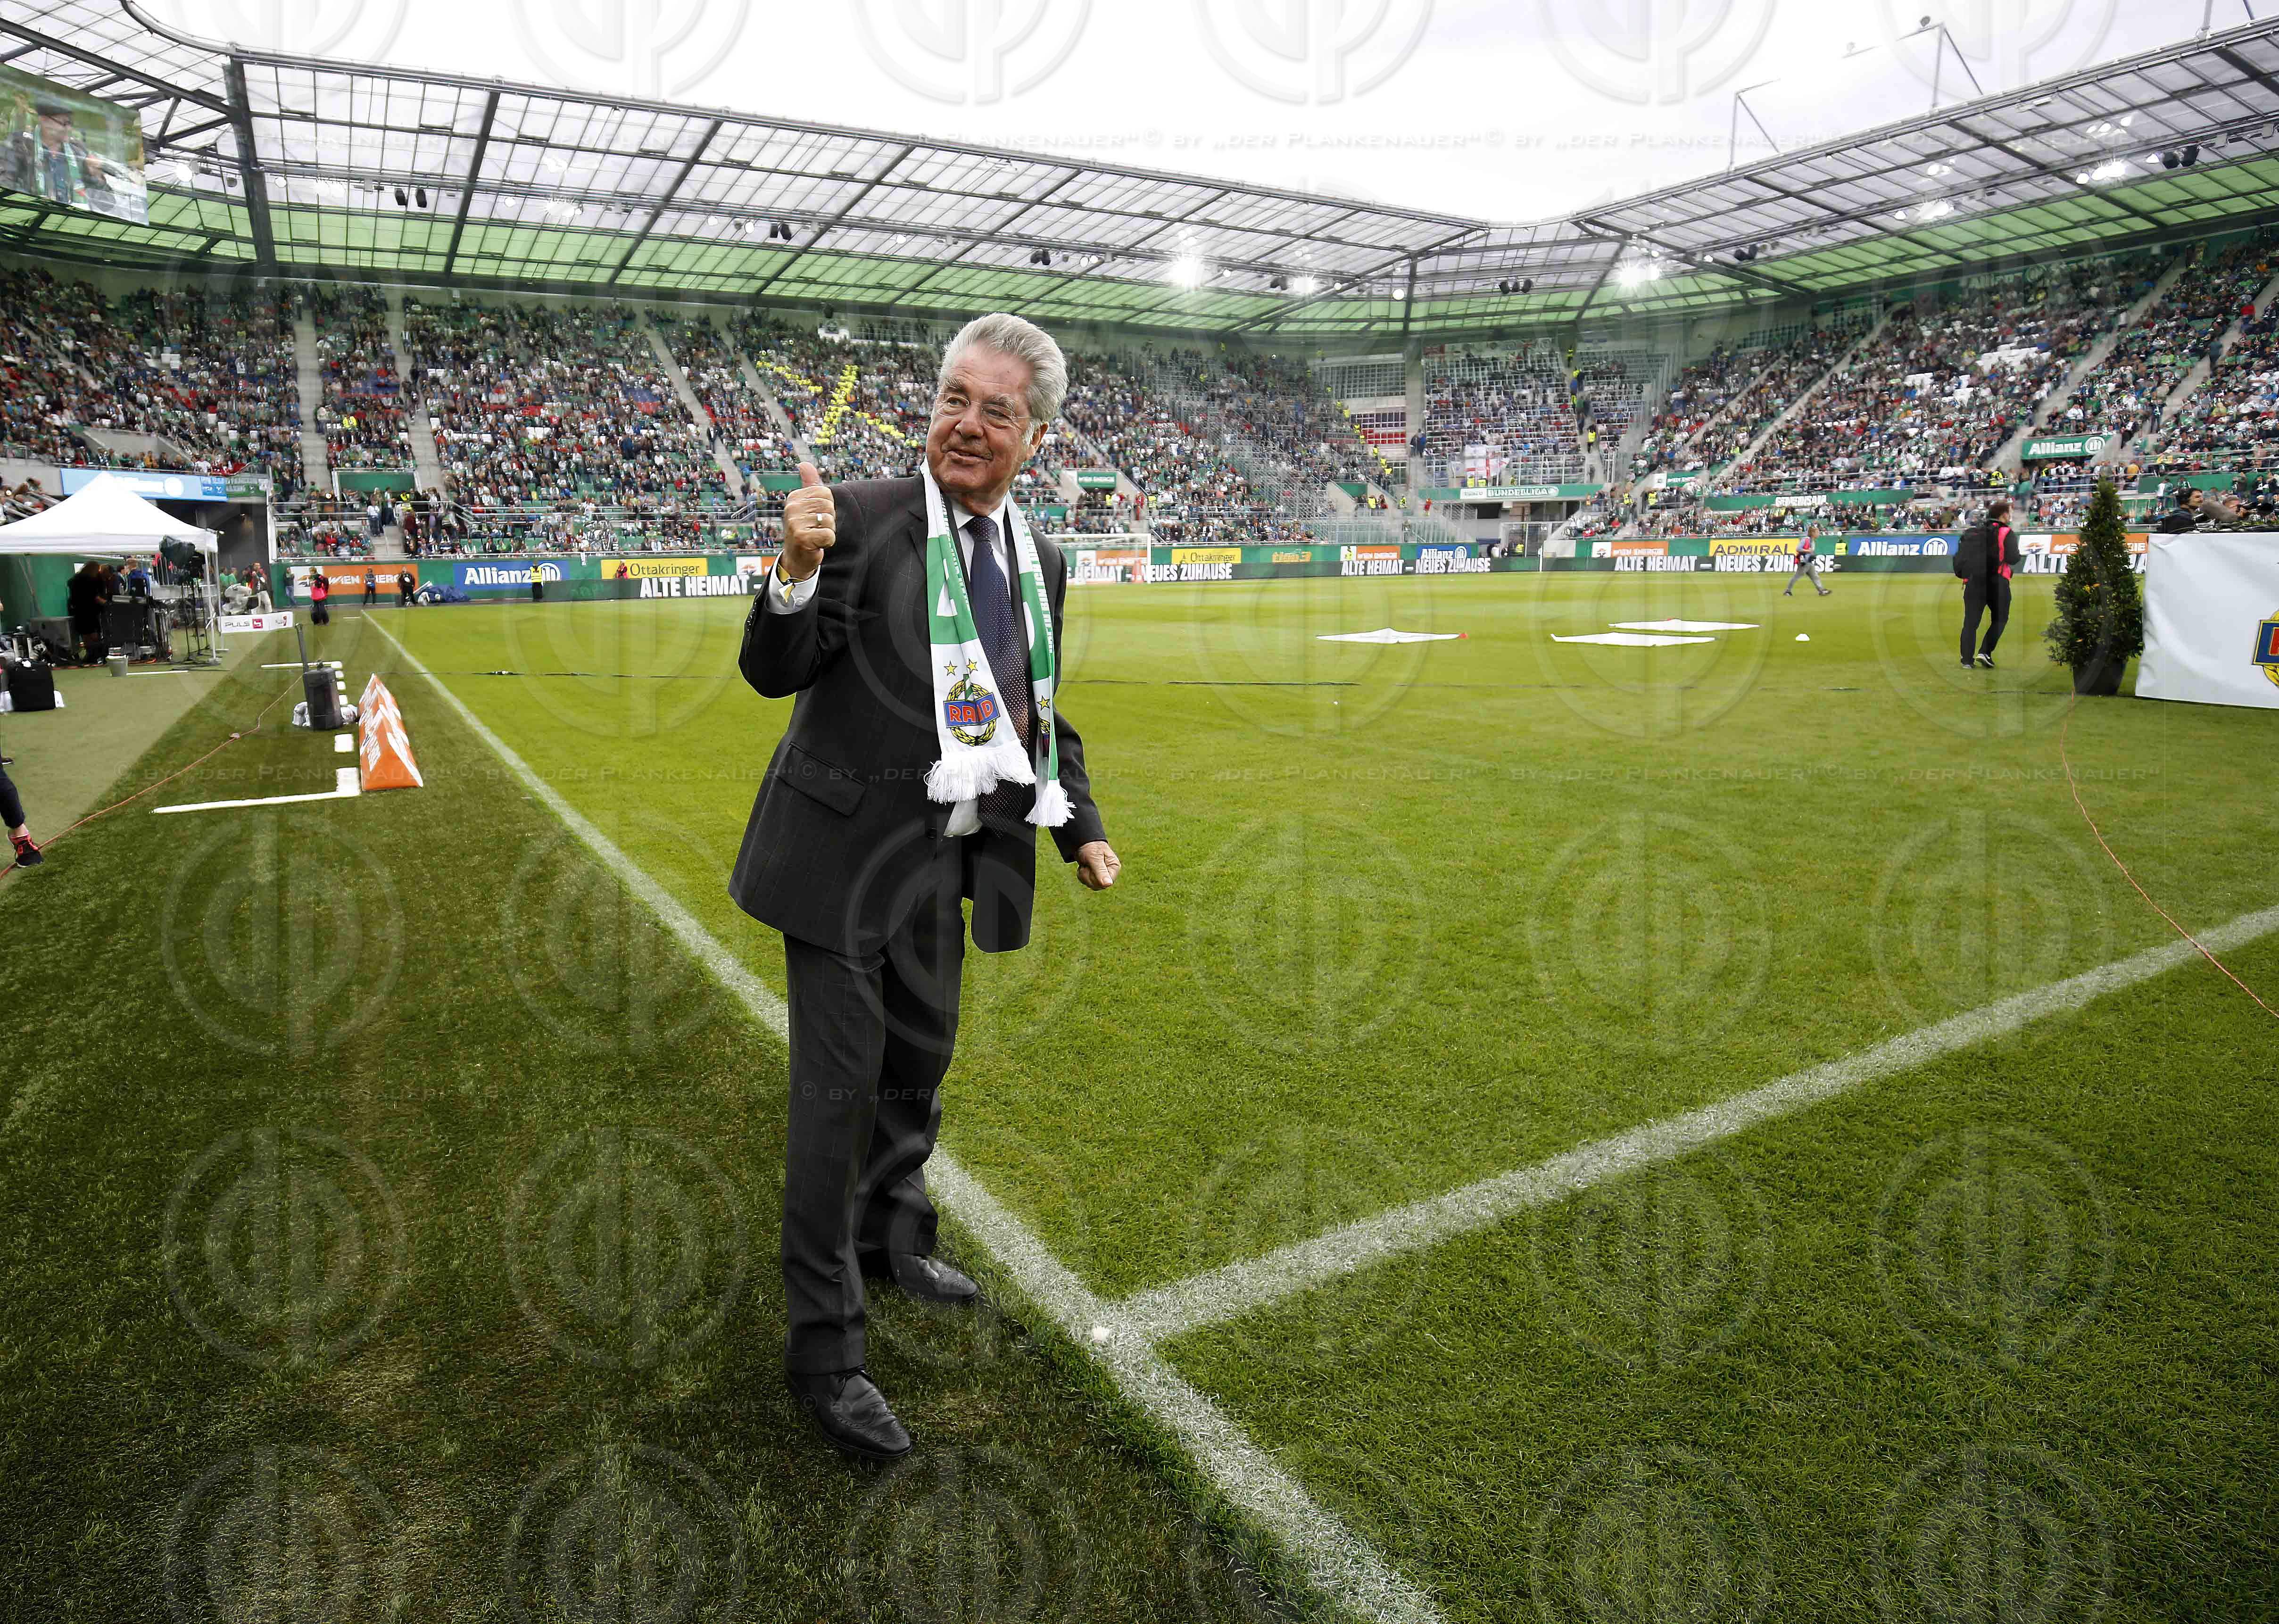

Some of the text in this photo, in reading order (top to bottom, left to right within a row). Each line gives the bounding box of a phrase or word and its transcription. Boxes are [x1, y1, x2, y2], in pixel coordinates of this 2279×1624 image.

[2028, 442, 2082, 455] Allianz
[1421, 548, 1454, 558] Allianz
[1714, 543, 1795, 555] ADMIRAL
[1857, 541, 1920, 555] Allianz
[630, 563, 701, 576] Ottakringer
[1341, 560, 1365, 575] ALTE
[1367, 559, 1404, 575] HEIMAT
[1416, 558, 1446, 573] NEUES
[1447, 557, 1491, 572] ZUHAUSE
[1614, 555, 1645, 571] ALTE
[1647, 555, 1698, 571] HEIMAT
[1715, 554, 1762, 572] NEUES
[1764, 554, 1834, 572] ZUHSE
[464, 566, 531, 585] Allianz
[1179, 563, 1233, 581] ZUHAUSE
[639, 576, 680, 598] ALTE
[684, 574, 750, 597] HEIMAT
